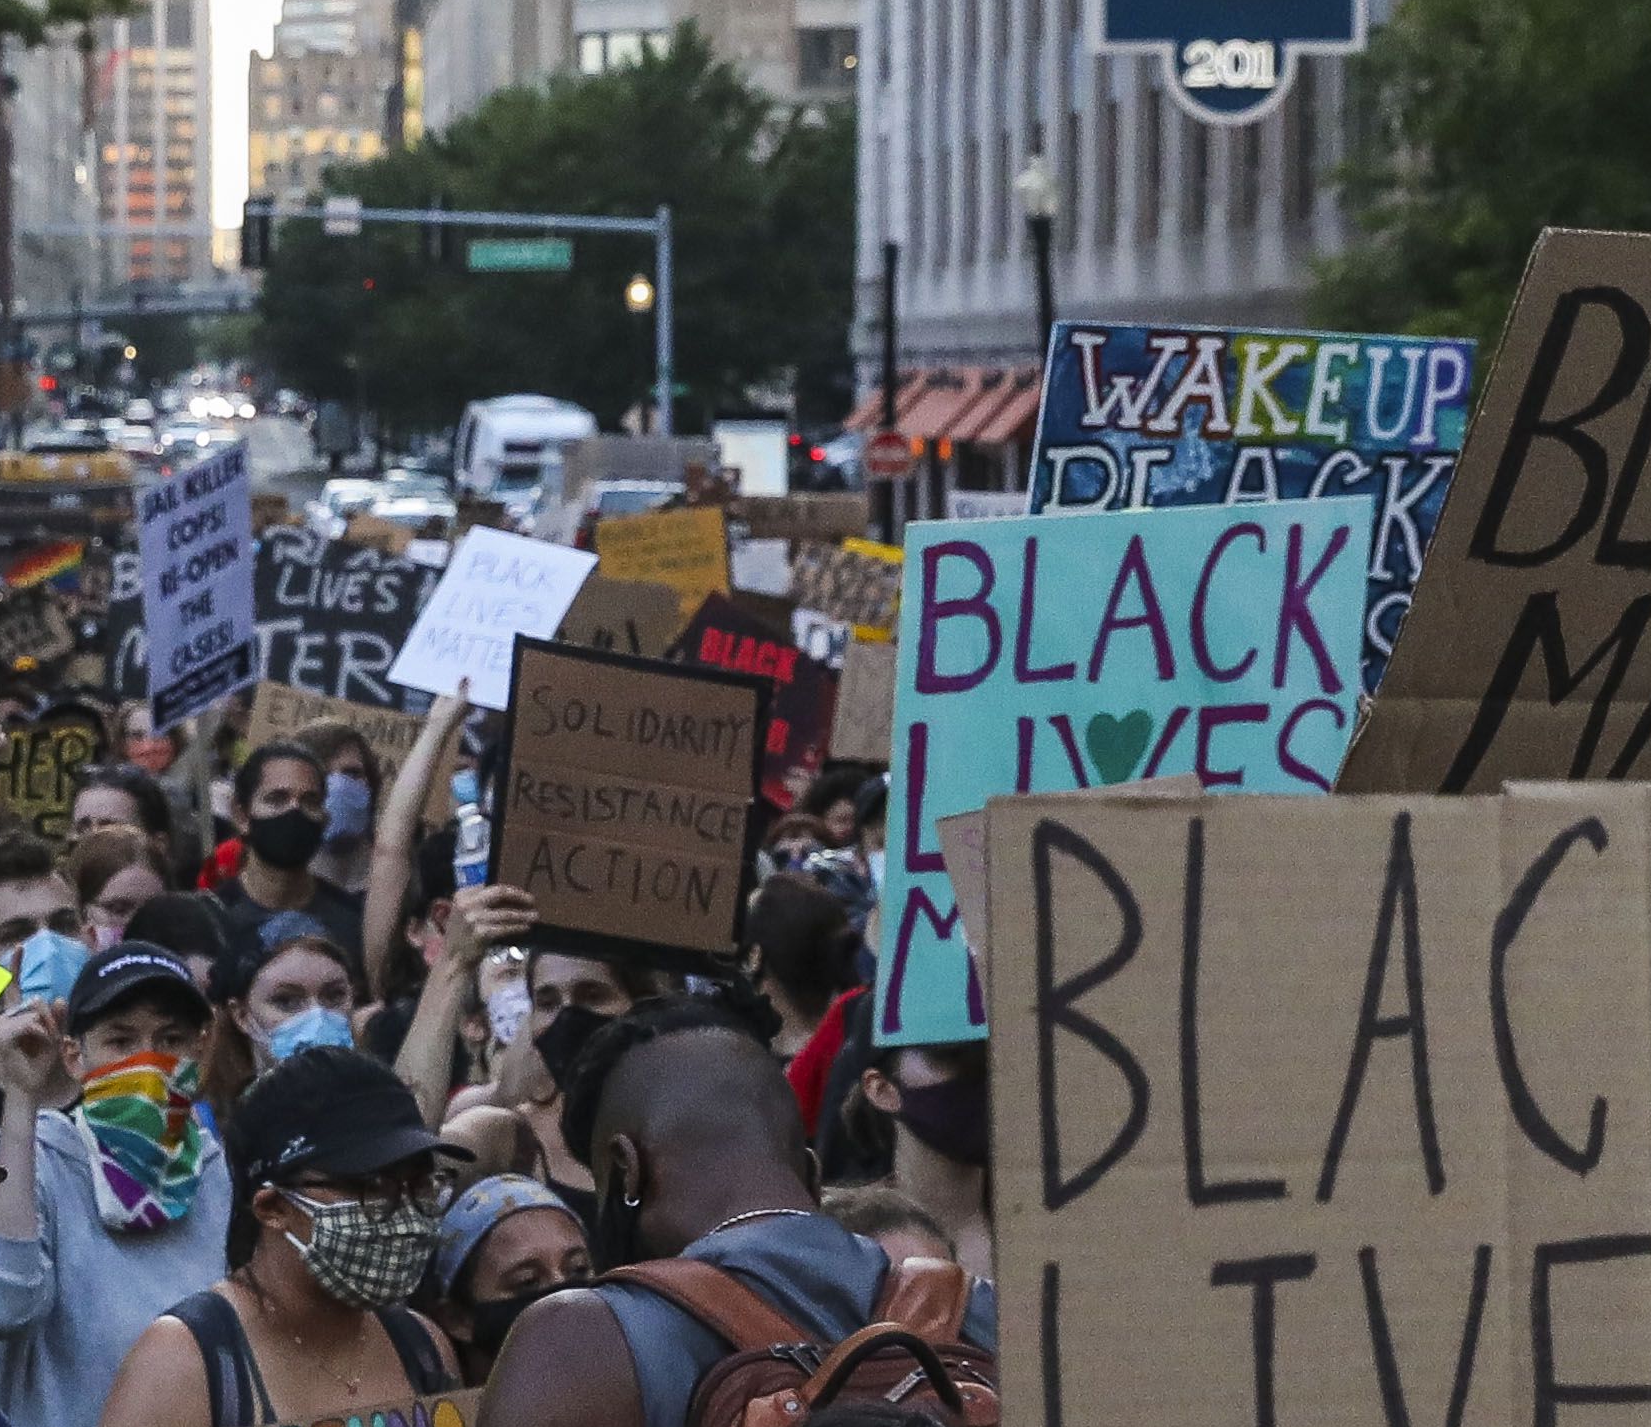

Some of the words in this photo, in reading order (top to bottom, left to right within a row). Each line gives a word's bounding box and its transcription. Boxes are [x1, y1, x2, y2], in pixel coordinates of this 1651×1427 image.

[1182, 38, 1276, 89] 201
[914, 522, 1352, 694] BLACK
[417, 626, 511, 671] MATTE
[700, 625, 799, 684] BLACK
[530, 684, 748, 769] SOLIDARITY
[513, 771, 743, 844] RESISTANCE
[525, 836, 719, 917] ACTION
